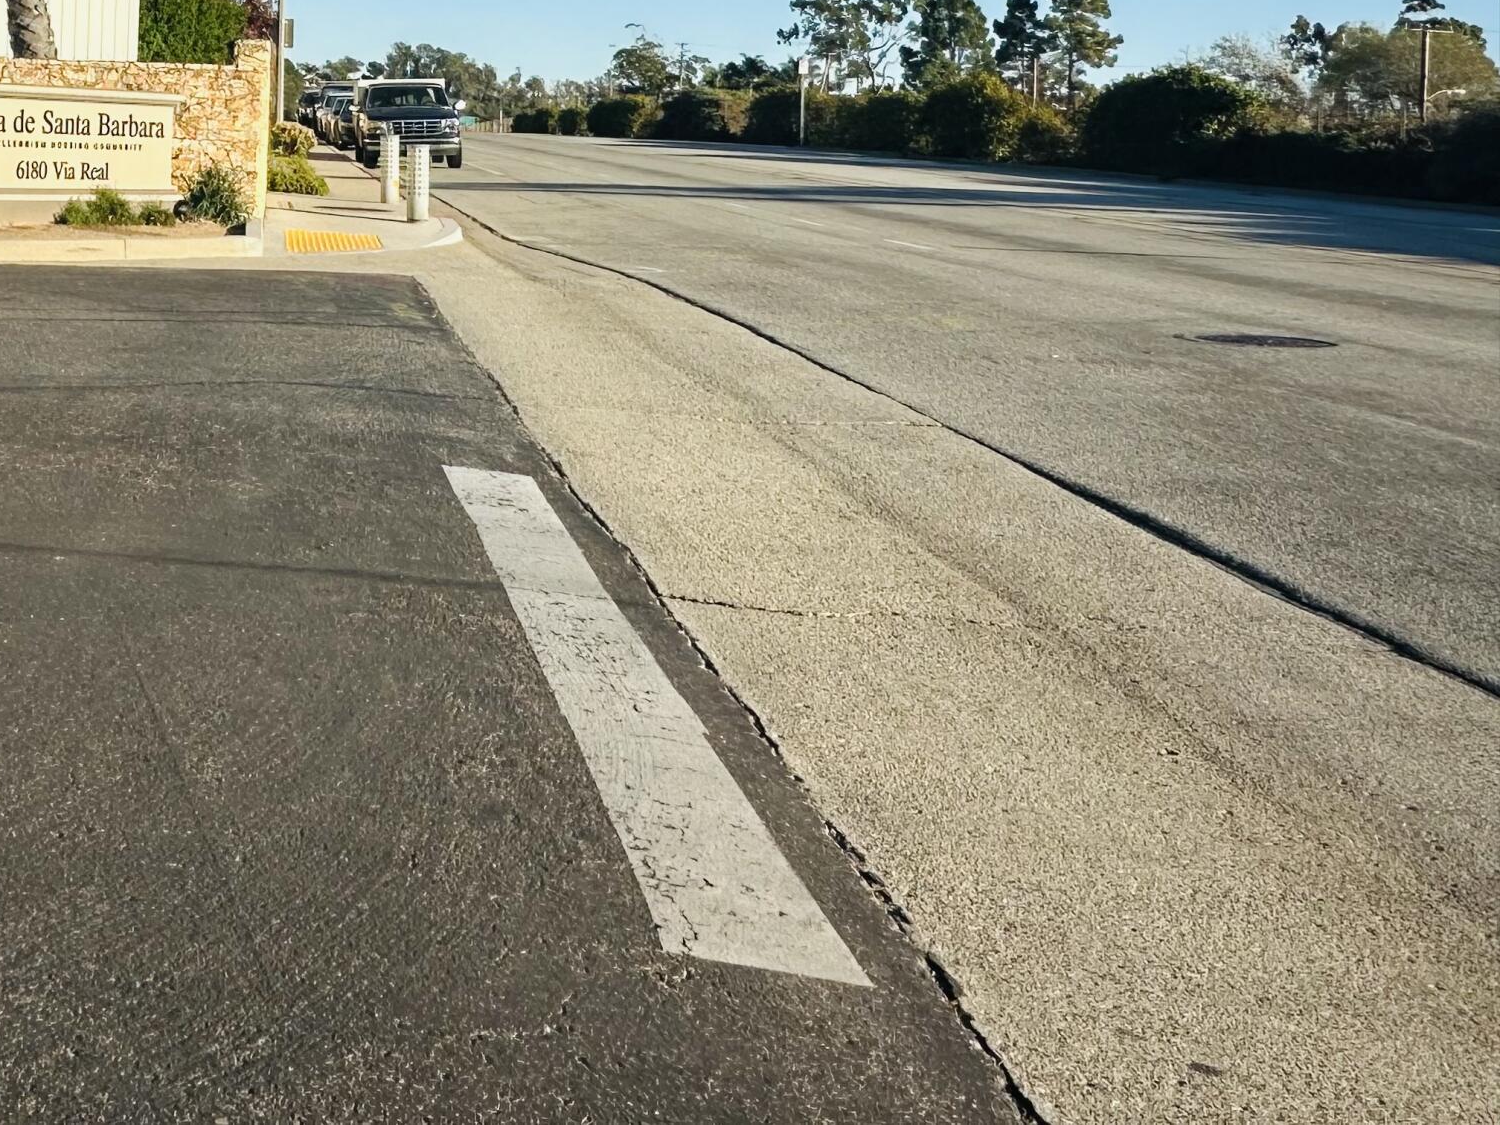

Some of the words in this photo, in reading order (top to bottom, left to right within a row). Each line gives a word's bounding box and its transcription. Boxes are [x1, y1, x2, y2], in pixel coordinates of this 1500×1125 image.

[13, 108, 36, 134] de
[42, 110, 91, 137] Santa
[98, 112, 165, 139] Barbara
[16, 160, 48, 180] 6180
[53, 161, 76, 180] Via
[81, 162, 109, 181] Real
